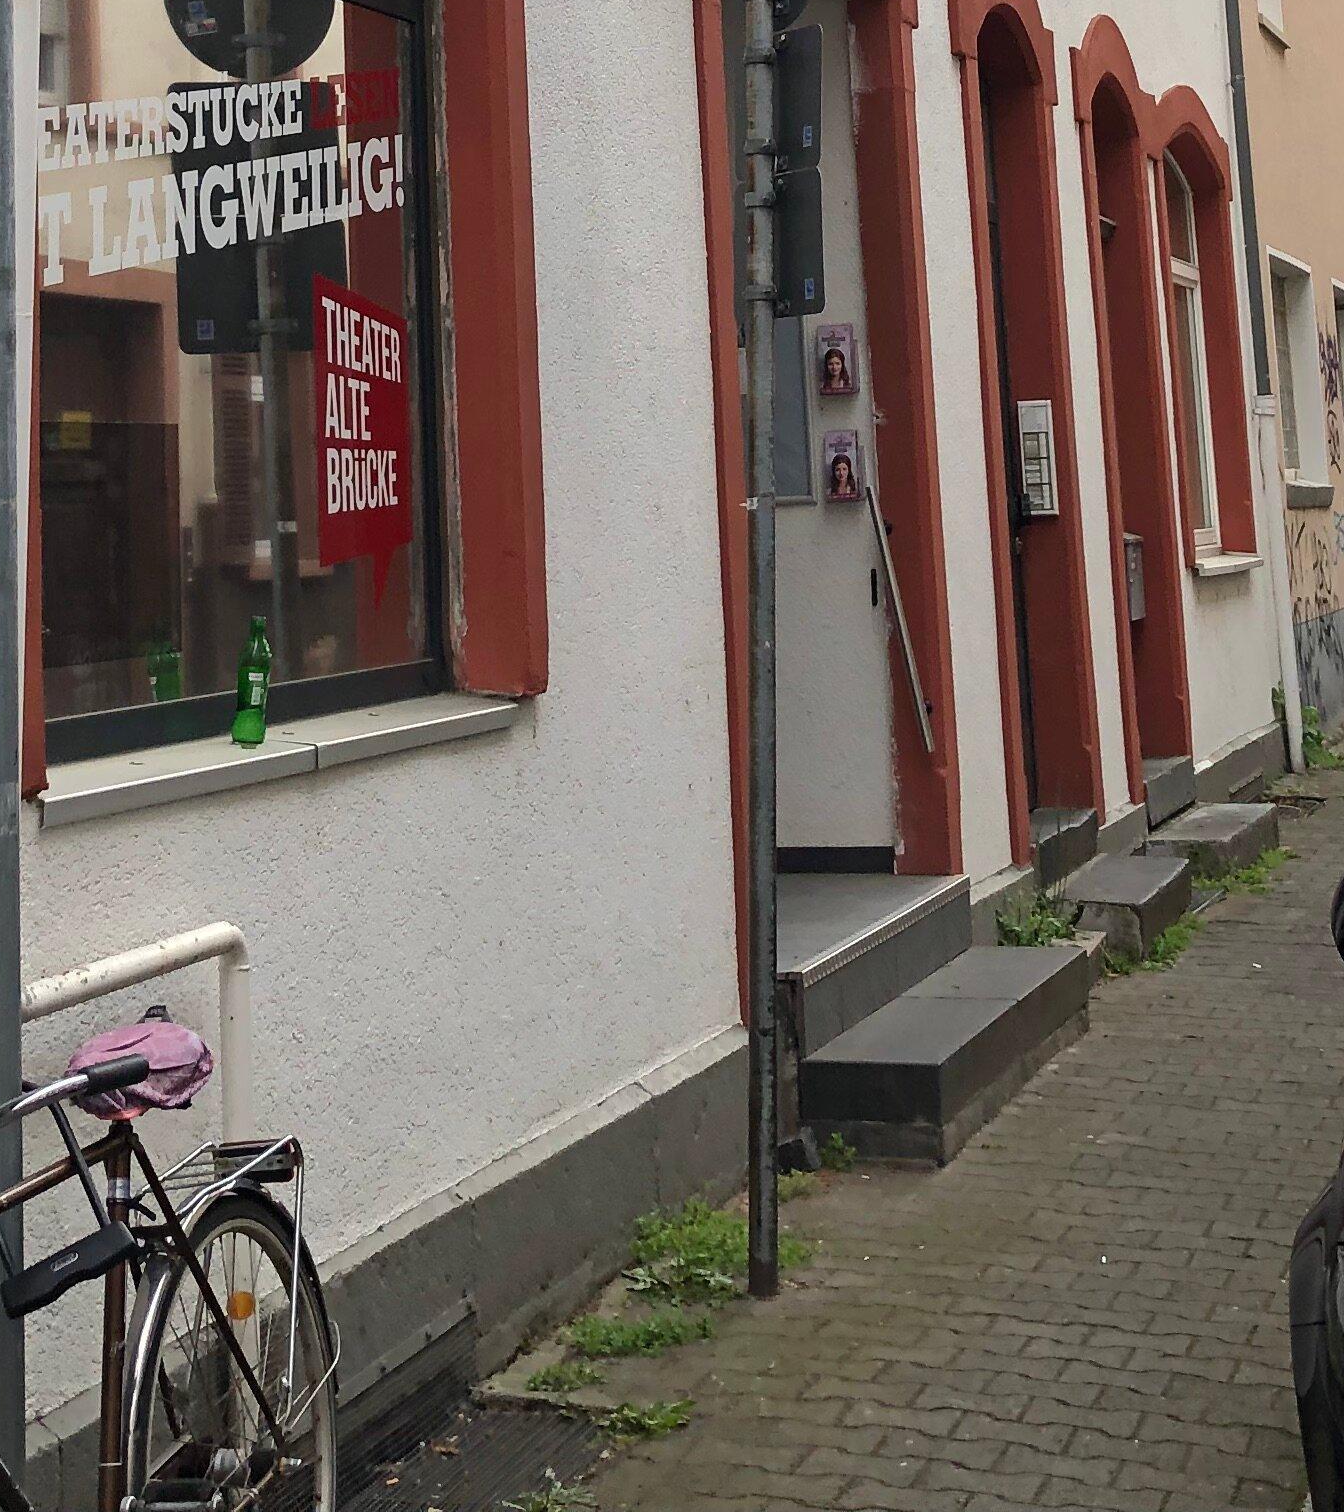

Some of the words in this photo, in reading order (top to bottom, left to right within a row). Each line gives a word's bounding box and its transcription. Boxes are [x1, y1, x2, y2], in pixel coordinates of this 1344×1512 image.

[89, 134, 405, 277] LANGWEILIG!
[321, 295, 402, 383] THEATER
[325, 372, 372, 441] ALTE
